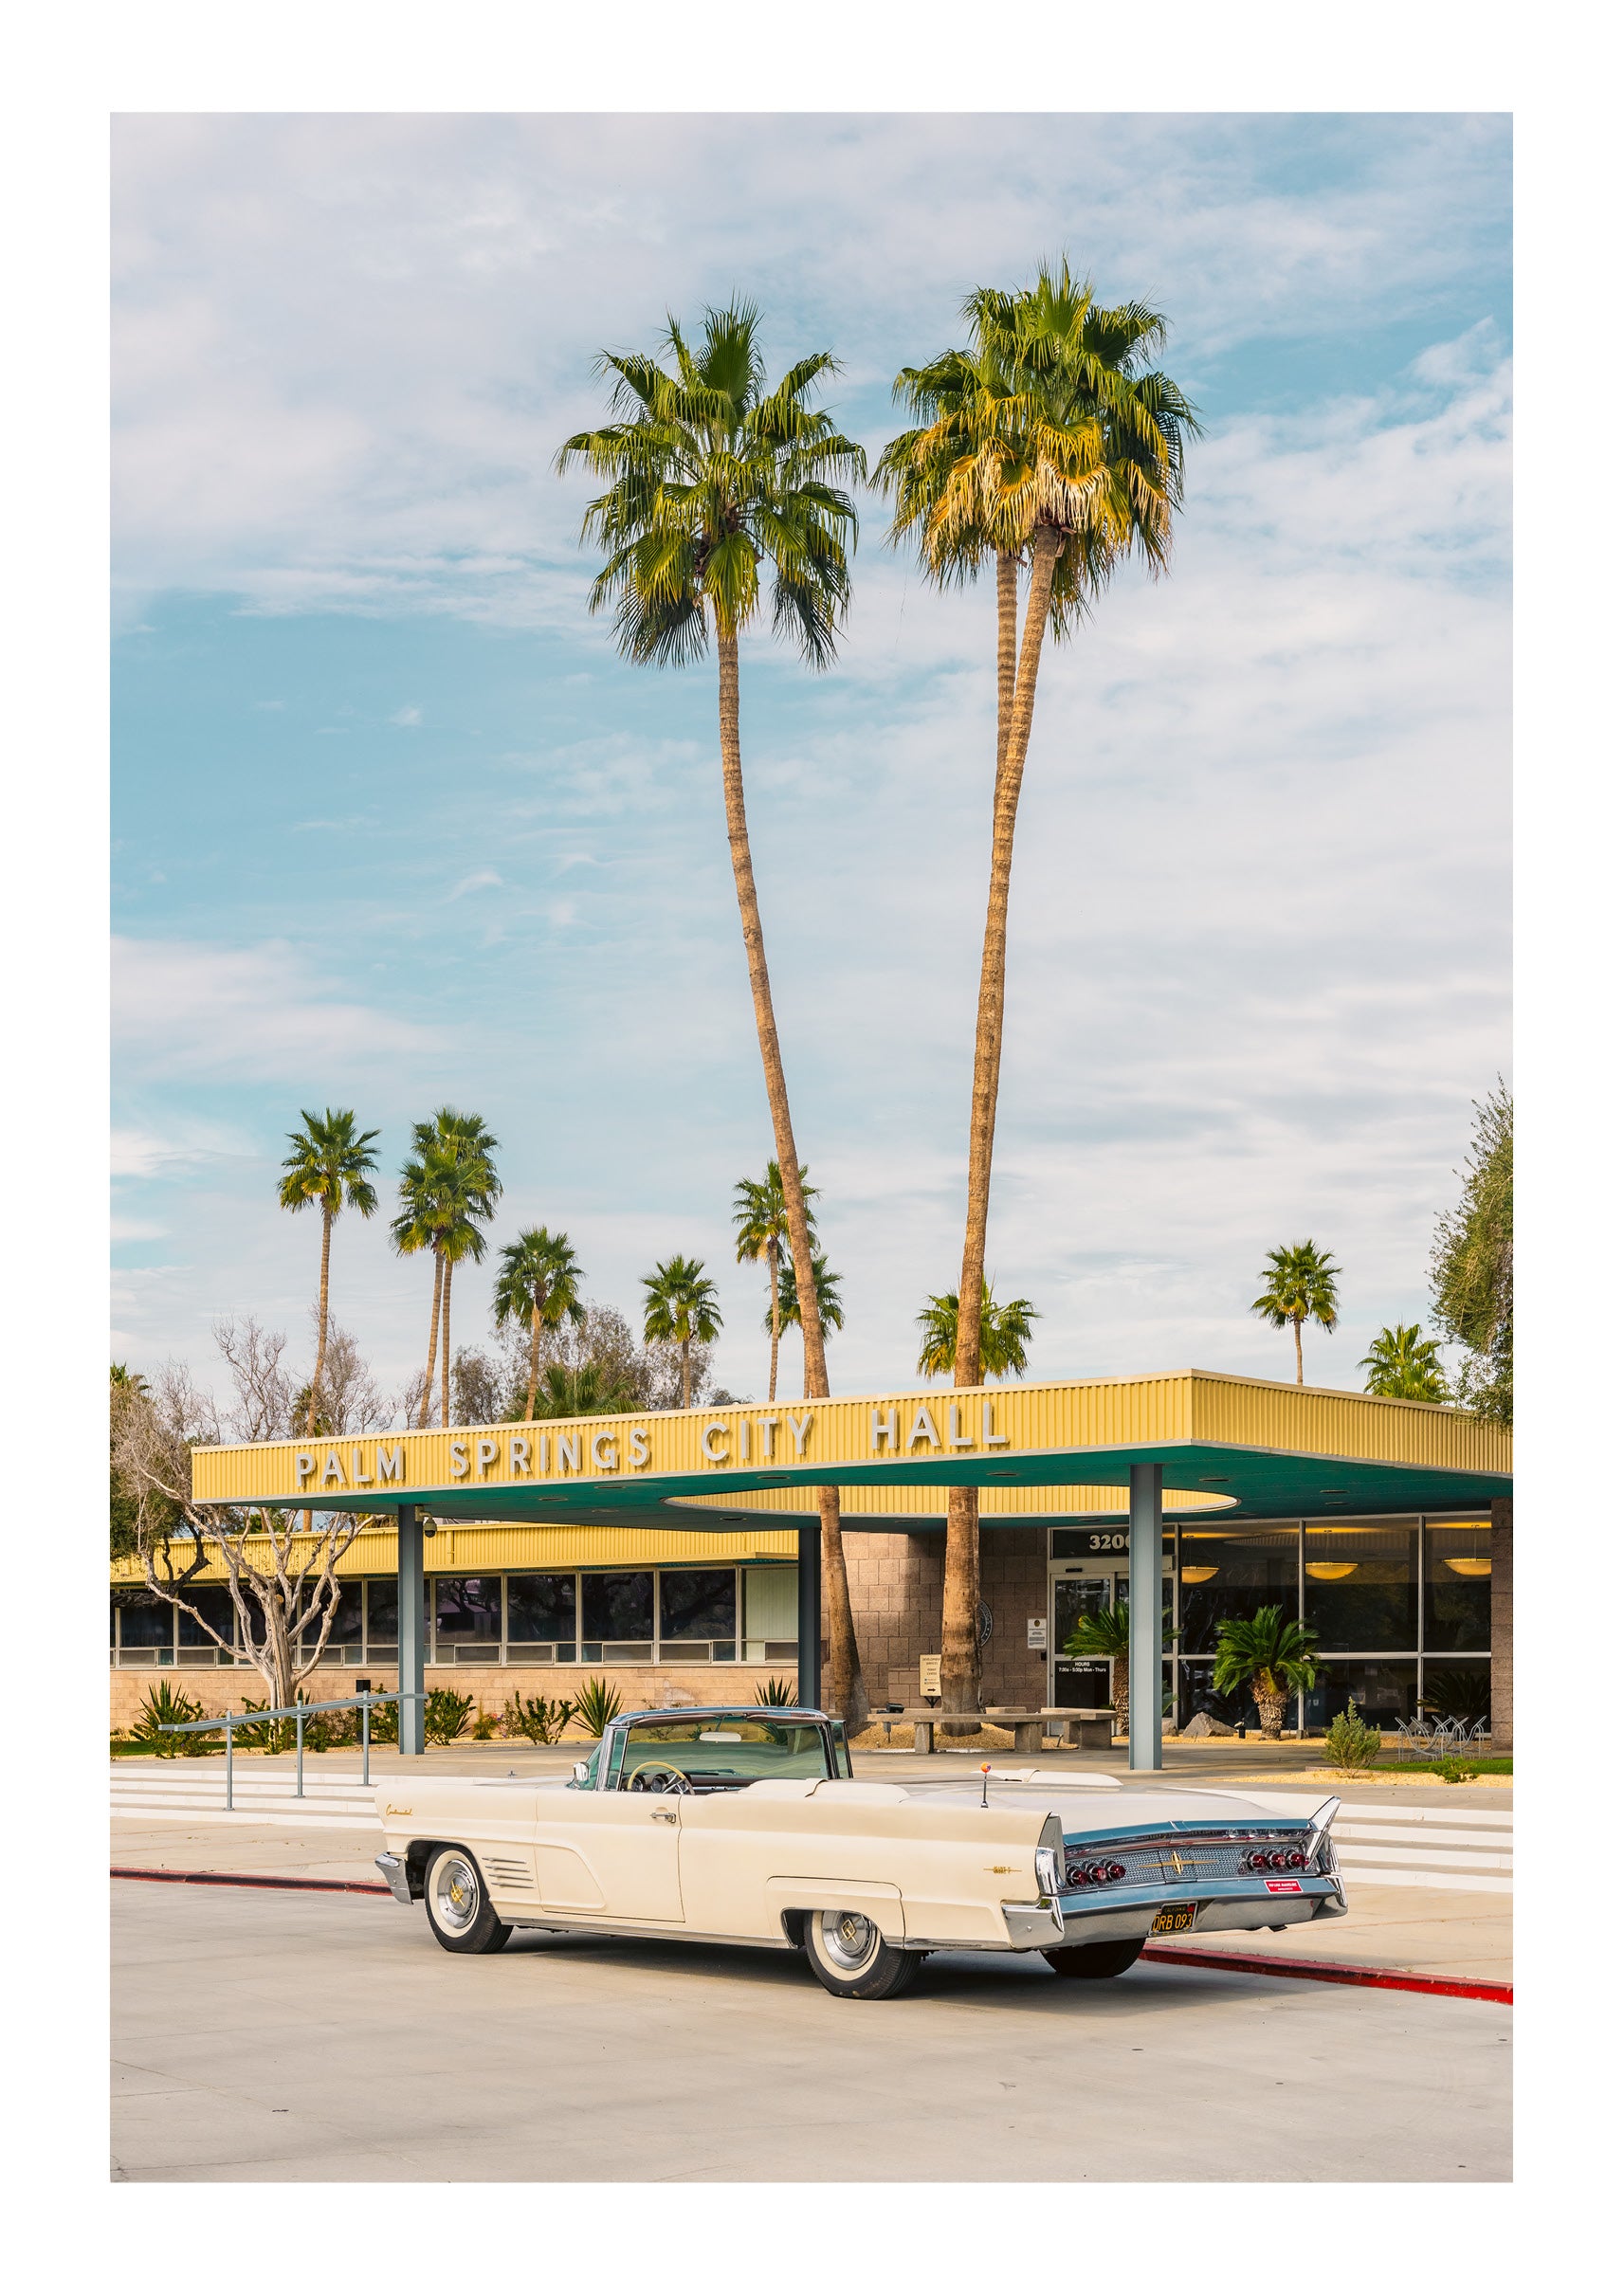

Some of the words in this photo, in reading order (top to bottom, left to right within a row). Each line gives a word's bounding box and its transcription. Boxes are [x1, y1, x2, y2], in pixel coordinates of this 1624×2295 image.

[296, 1445, 406, 1487] PALM
[449, 1428, 651, 1478] SPRINGS
[702, 1413, 813, 1463] CITY
[871, 1401, 1008, 1450] HALL
[1152, 1914, 1174, 1931] DRB
[1175, 1913, 1194, 1929] 093
